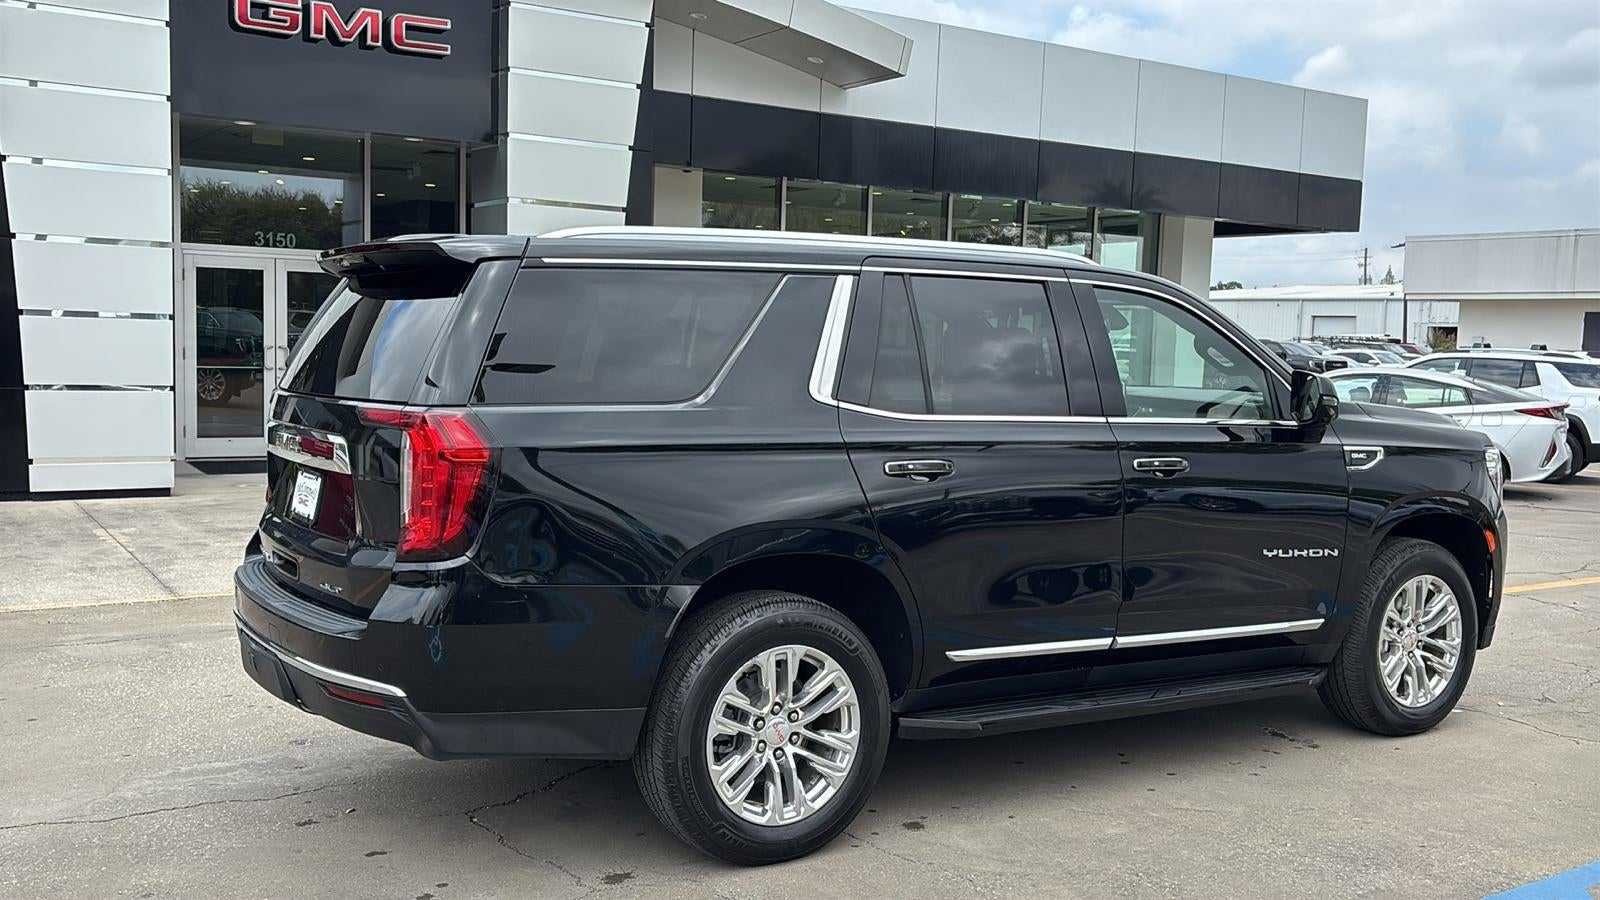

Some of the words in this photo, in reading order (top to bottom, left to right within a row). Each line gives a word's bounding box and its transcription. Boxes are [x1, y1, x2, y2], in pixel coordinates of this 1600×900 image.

[229, 0, 452, 58] GMC
[254, 230, 297, 248] 3150
[1262, 548, 1340, 558] YUKON
[803, 621, 856, 649] MICHELIN
